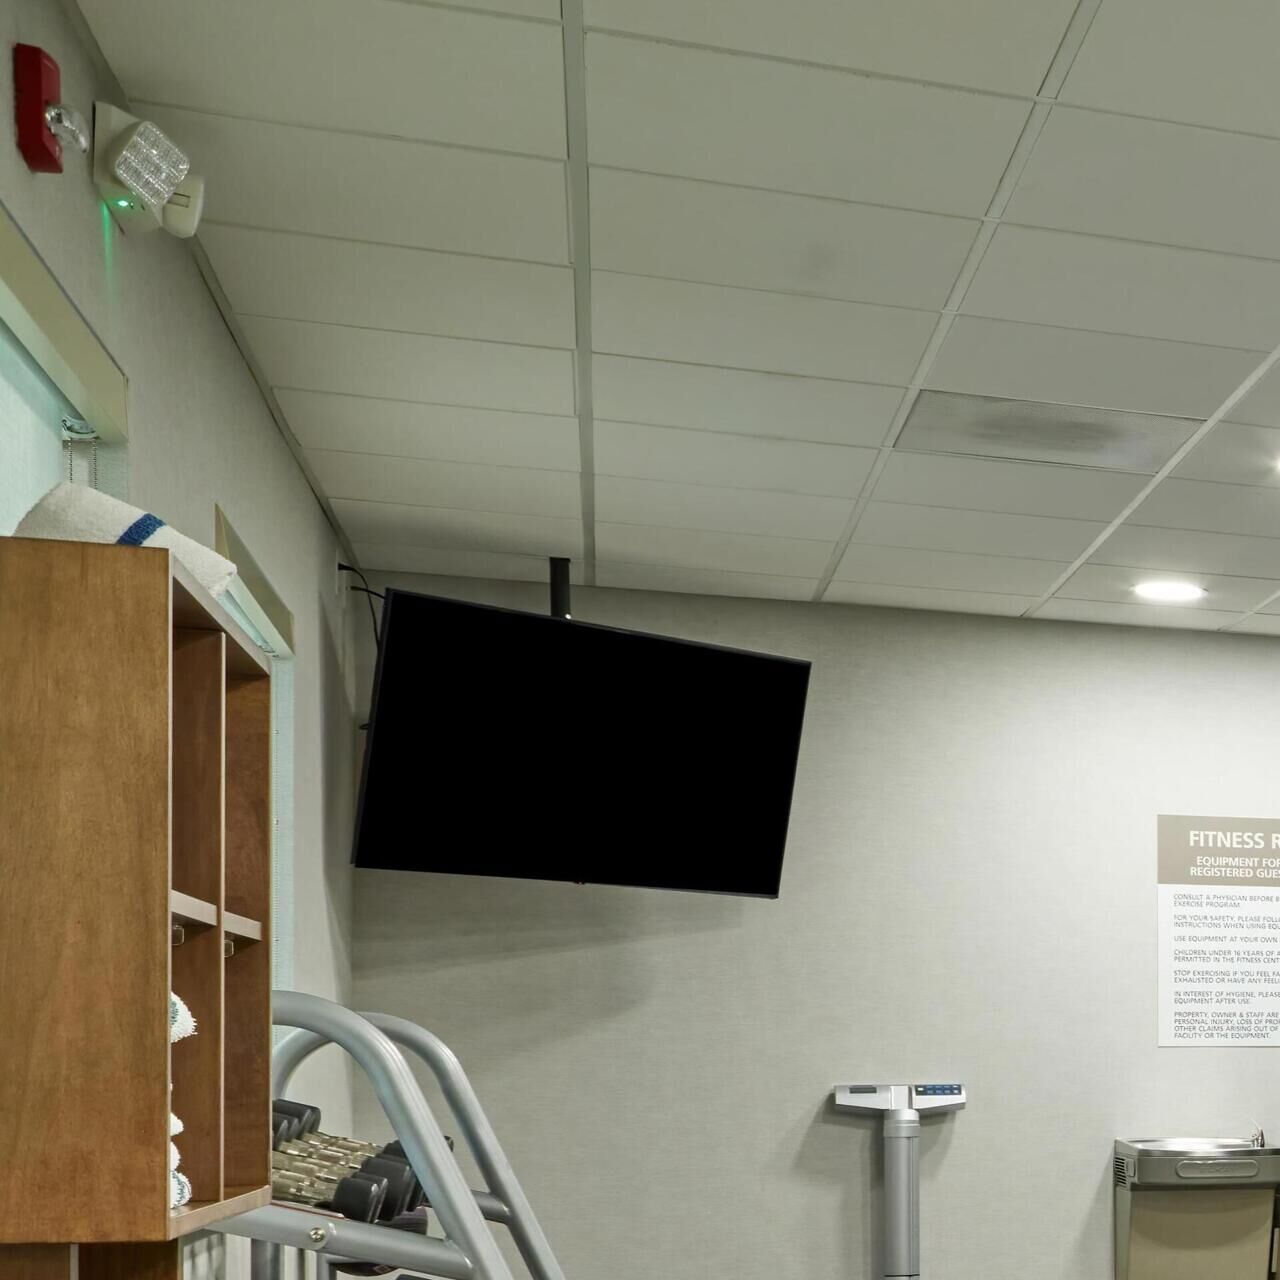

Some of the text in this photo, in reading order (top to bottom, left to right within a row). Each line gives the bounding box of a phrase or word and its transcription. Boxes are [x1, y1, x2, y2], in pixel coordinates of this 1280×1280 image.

[1190, 830, 1264, 849] FITNESS
[1197, 856, 1259, 868] EQUIPMENT
[1190, 866, 1253, 878] REGISTERED
[1174, 893, 1203, 901] CONSULT
[1249, 895, 1273, 903] BEFORE
